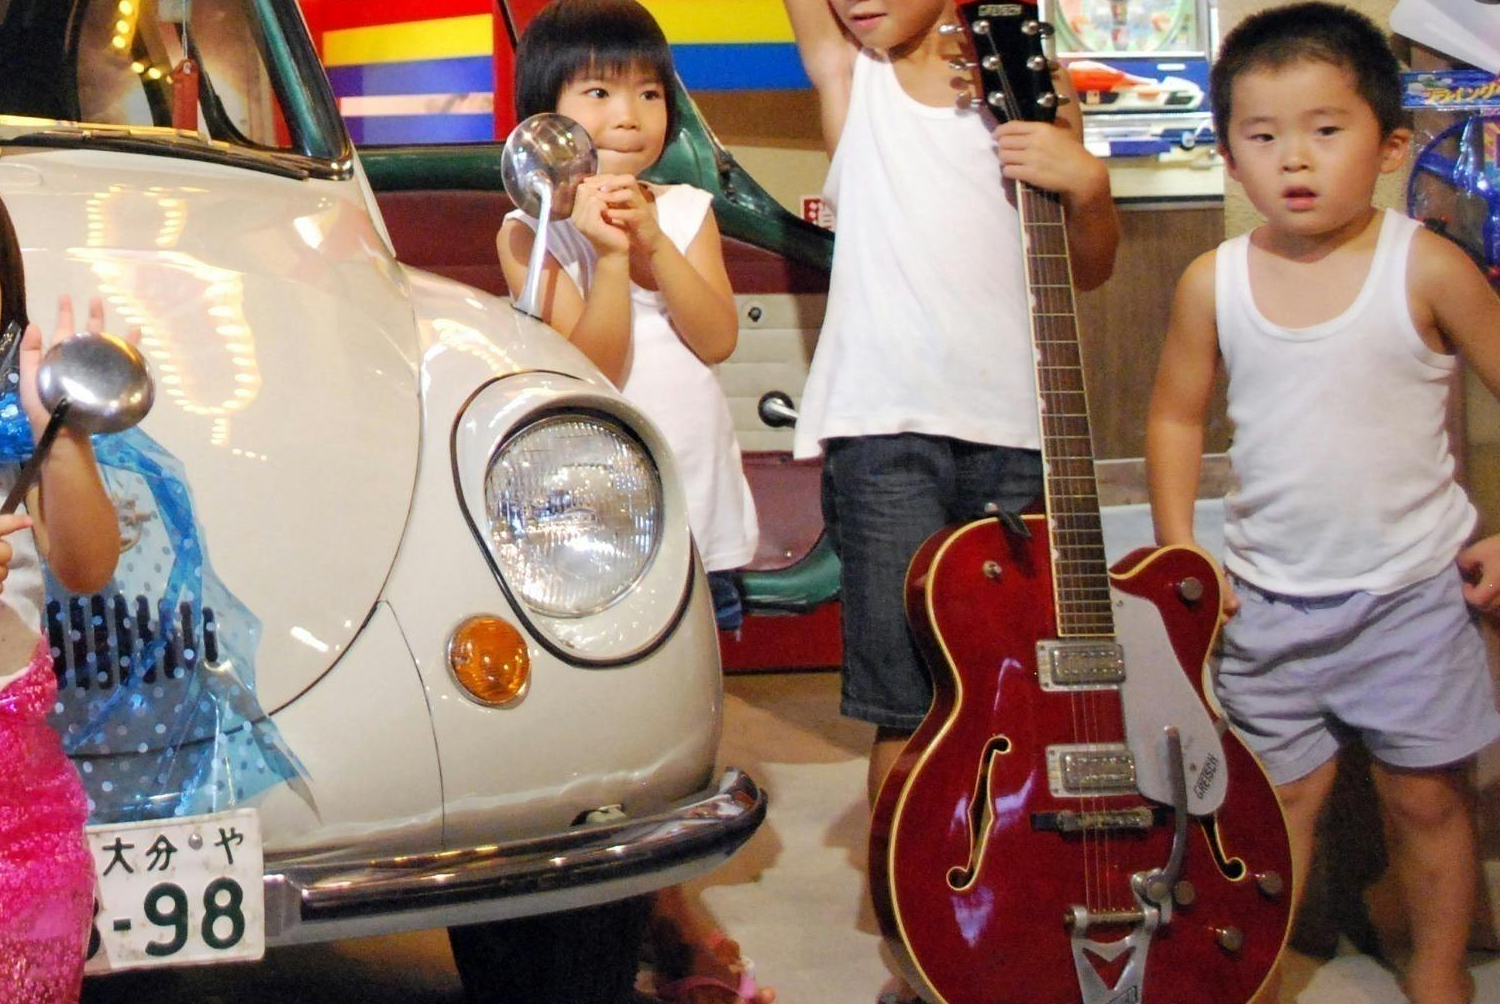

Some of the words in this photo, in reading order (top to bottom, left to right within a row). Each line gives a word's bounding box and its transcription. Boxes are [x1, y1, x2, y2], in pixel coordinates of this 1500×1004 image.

[1193, 752, 1219, 800] GRETSCH
[102, 835, 178, 877] 大分
[214, 827, 244, 865] や
[86, 876, 246, 961] -98
